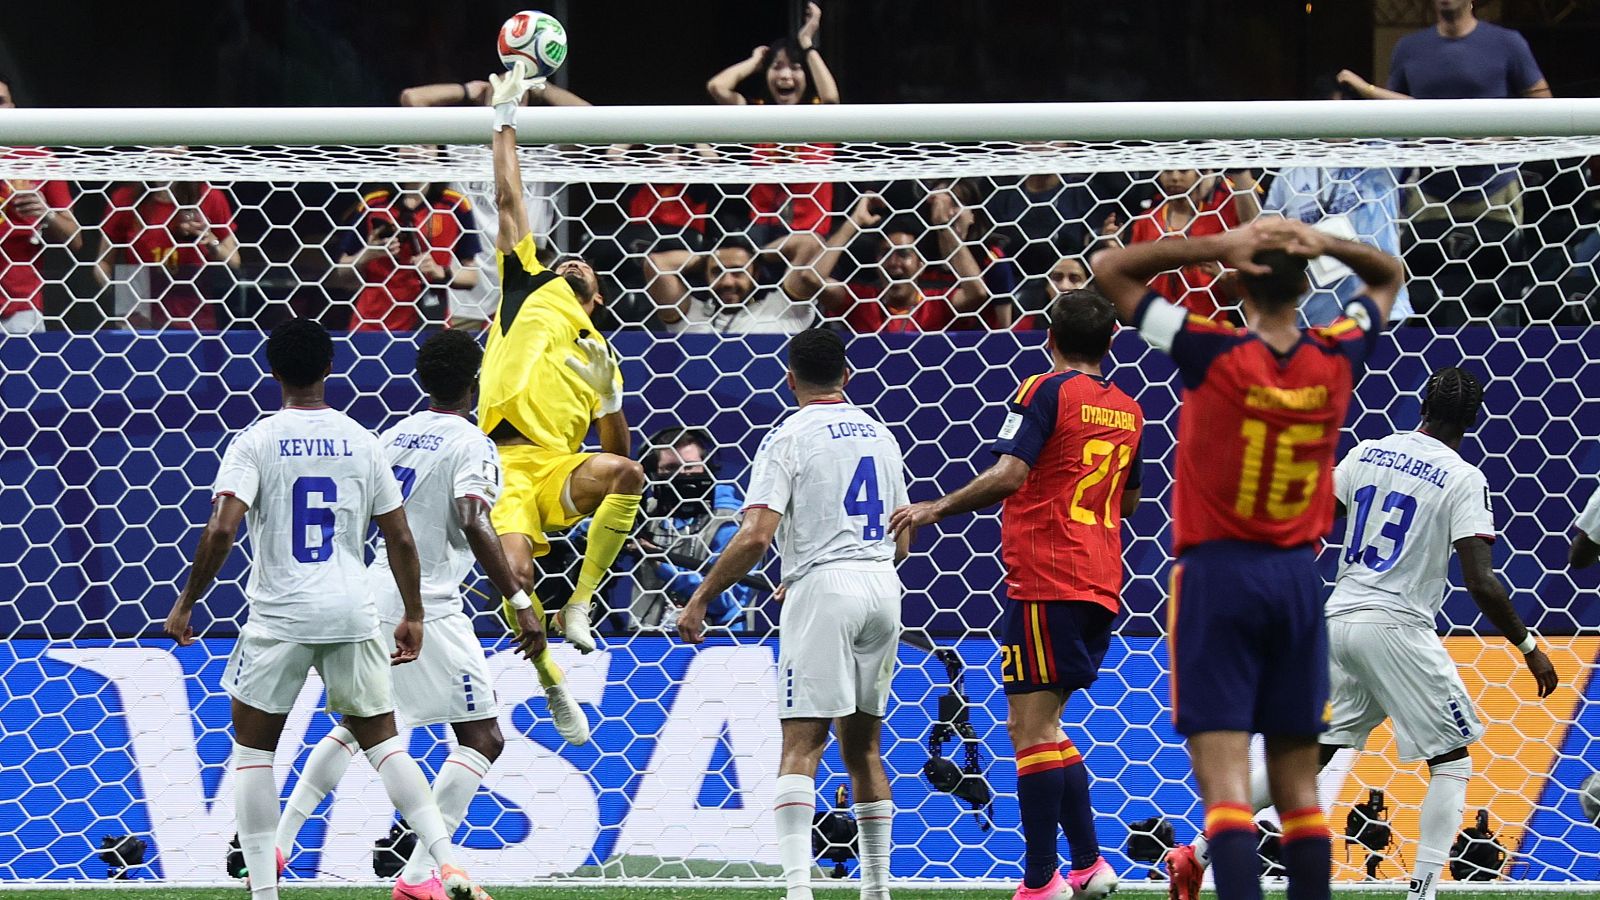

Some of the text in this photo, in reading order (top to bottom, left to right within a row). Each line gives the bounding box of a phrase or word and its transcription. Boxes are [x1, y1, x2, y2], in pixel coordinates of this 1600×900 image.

[827, 421, 877, 440] LOPES
[1235, 418, 1325, 520] 16
[292, 476, 337, 564] 6
[843, 456, 884, 541] 4
[1070, 438, 1132, 529] 21
[1344, 484, 1418, 573] 13
[1001, 644, 1025, 682] 21
